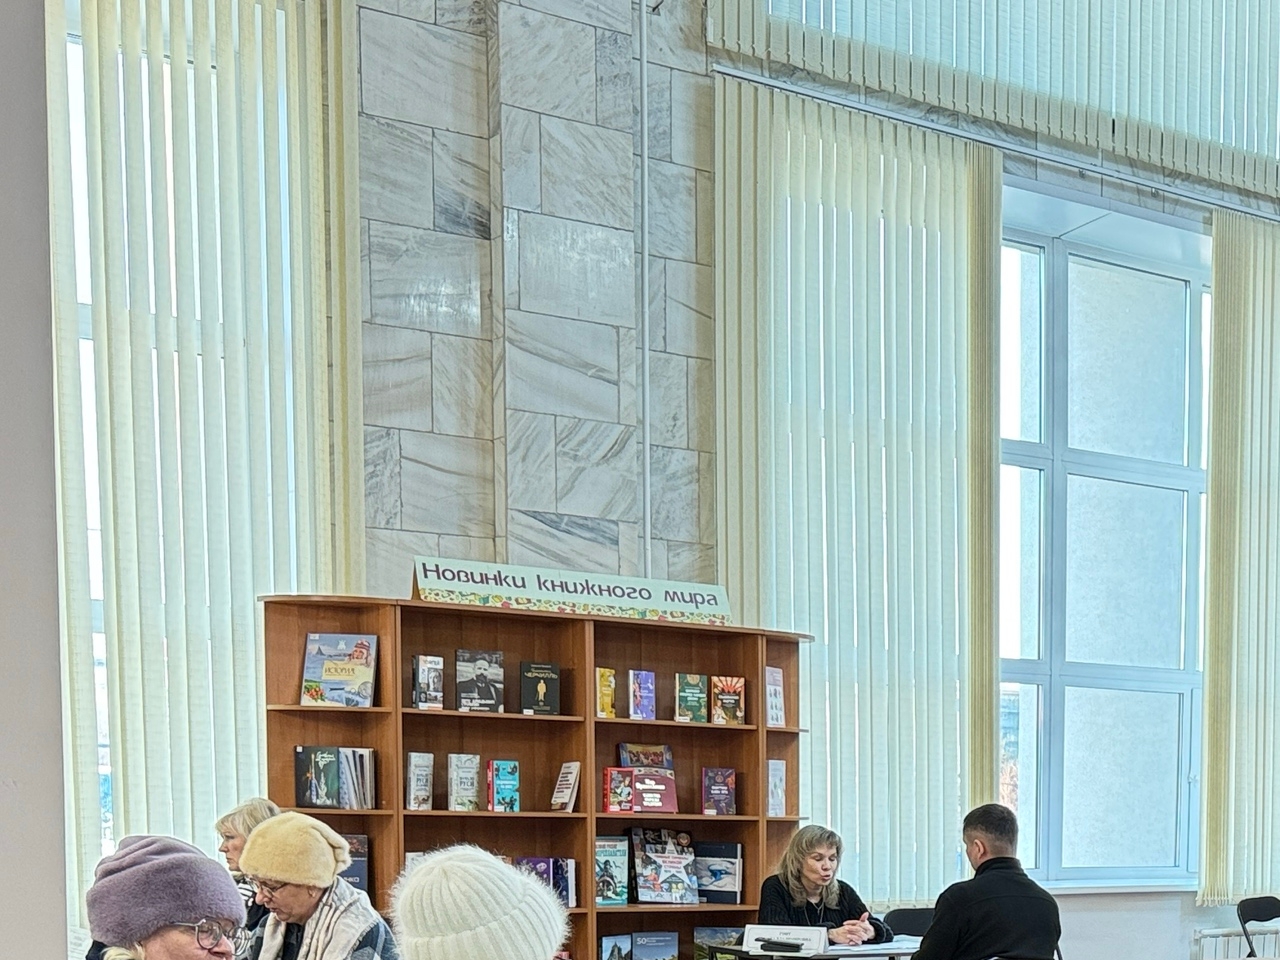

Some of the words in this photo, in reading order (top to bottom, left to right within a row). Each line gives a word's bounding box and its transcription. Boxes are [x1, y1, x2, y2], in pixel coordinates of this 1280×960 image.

[422, 563, 526, 590] Новинки
[537, 574, 652, 601] книжного
[664, 590, 718, 609] мира
